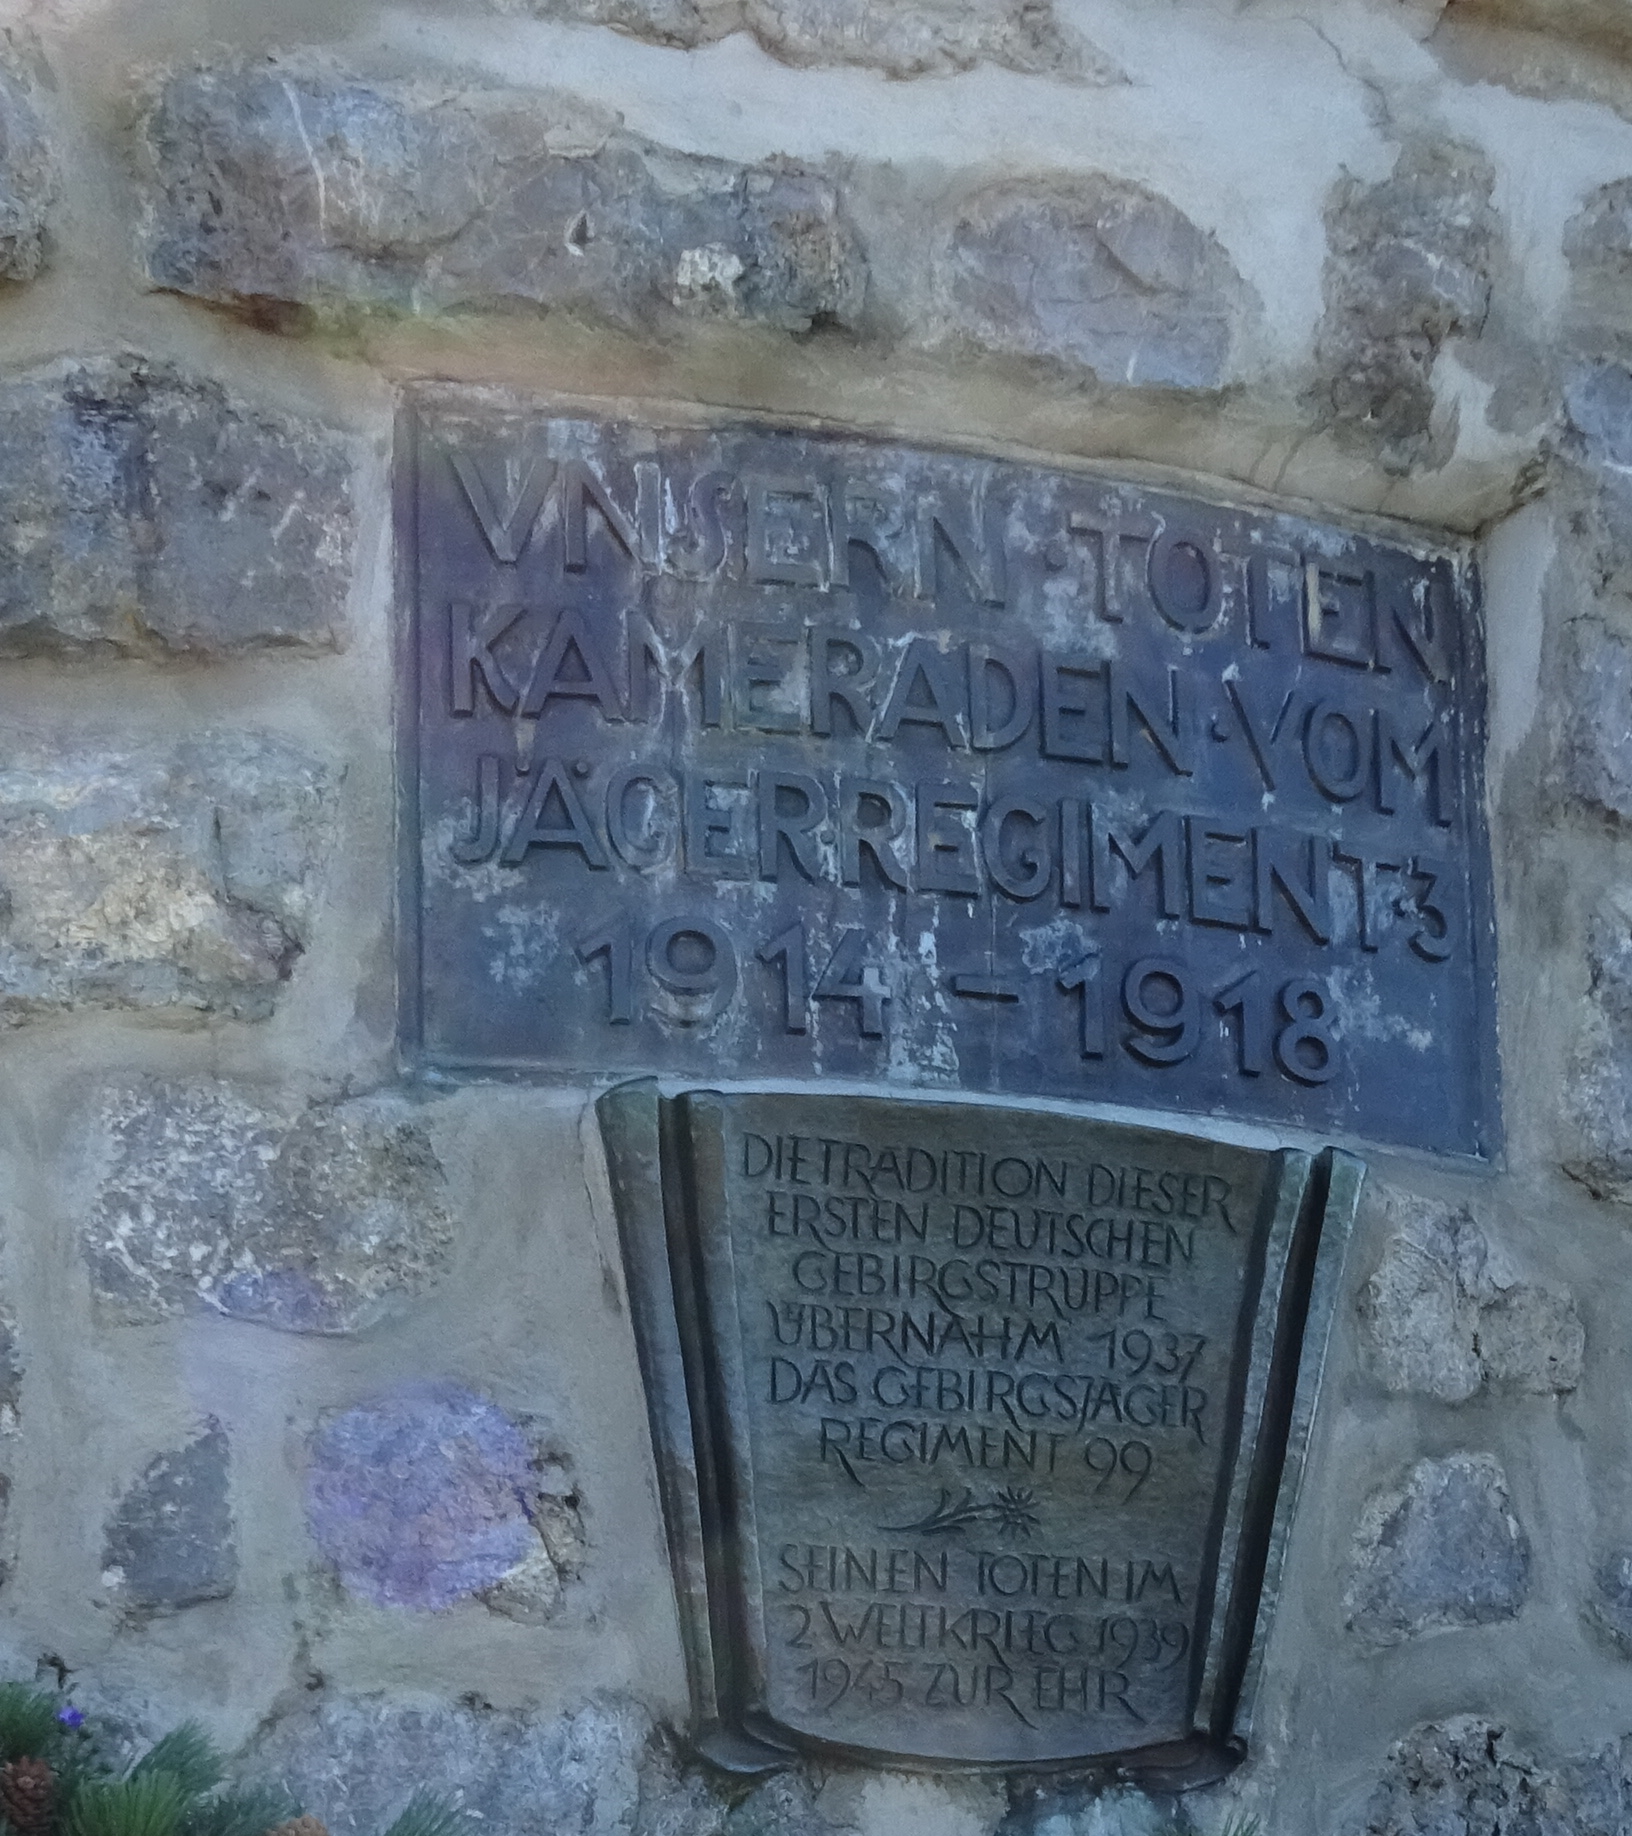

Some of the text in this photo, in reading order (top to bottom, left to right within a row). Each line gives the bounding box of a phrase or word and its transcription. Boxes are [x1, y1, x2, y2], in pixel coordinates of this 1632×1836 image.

[1068, 509, 1455, 684] TOTEN
[448, 602, 1453, 828] KAMERADEN VOM
[573, 911, 893, 1041] 1914
[1055, 950, 1340, 1087] 1918
[766, 1190, 1197, 1268] ERSTEN DEUTSCHEN
[1087, 1161, 1238, 1235] DIESER
[792, 1249, 1169, 1325] GEBIRGSTRUPPE
[769, 1356, 859, 1405] DAS
[1085, 1328, 1208, 1384] 1937
[820, 1416, 1153, 1502] REGIMENT 99
[777, 1542, 1186, 1607] SEINEN TOTEN IM
[818, 1599, 1080, 1675] WELTKRIEG
[1094, 1615, 1191, 1673] 1939
[795, 1657, 1149, 1731] 1945 ZUR EHR
